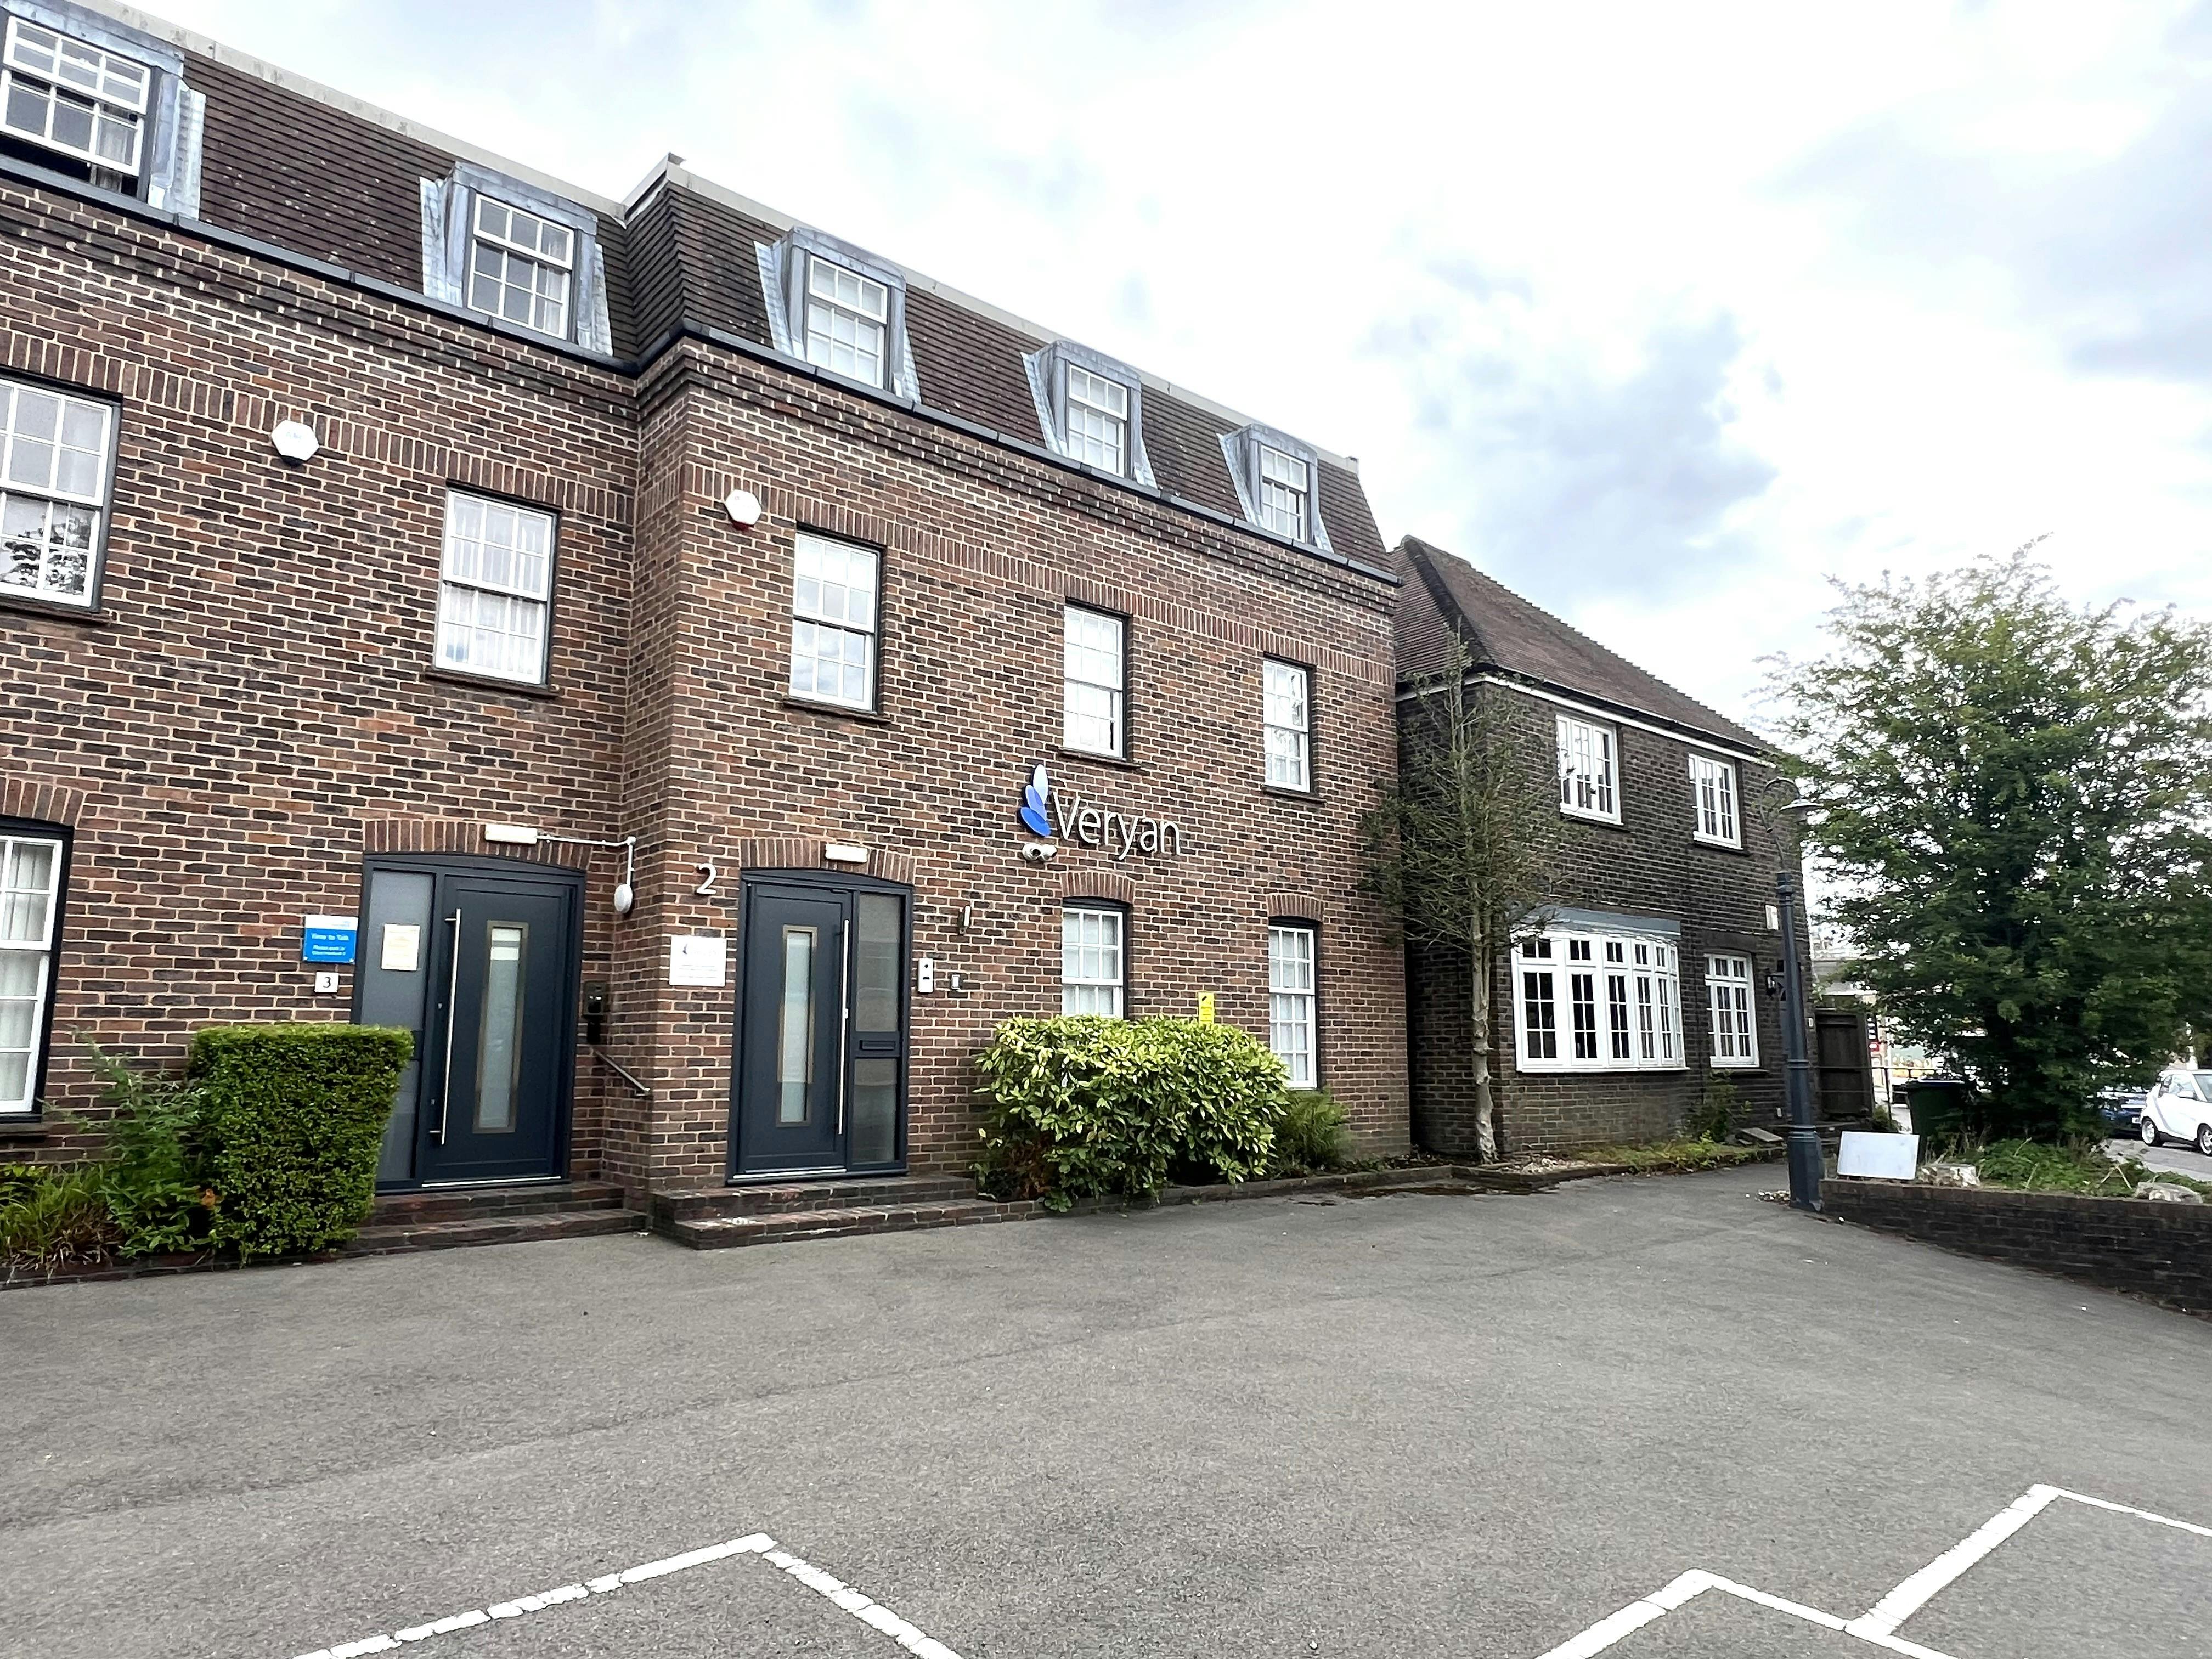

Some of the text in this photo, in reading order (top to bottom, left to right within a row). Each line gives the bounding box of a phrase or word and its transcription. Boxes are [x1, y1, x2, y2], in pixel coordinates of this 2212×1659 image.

[1053, 791, 1180, 861] Veryan
[697, 863, 716, 894] 2
[323, 977, 331, 988] 3
